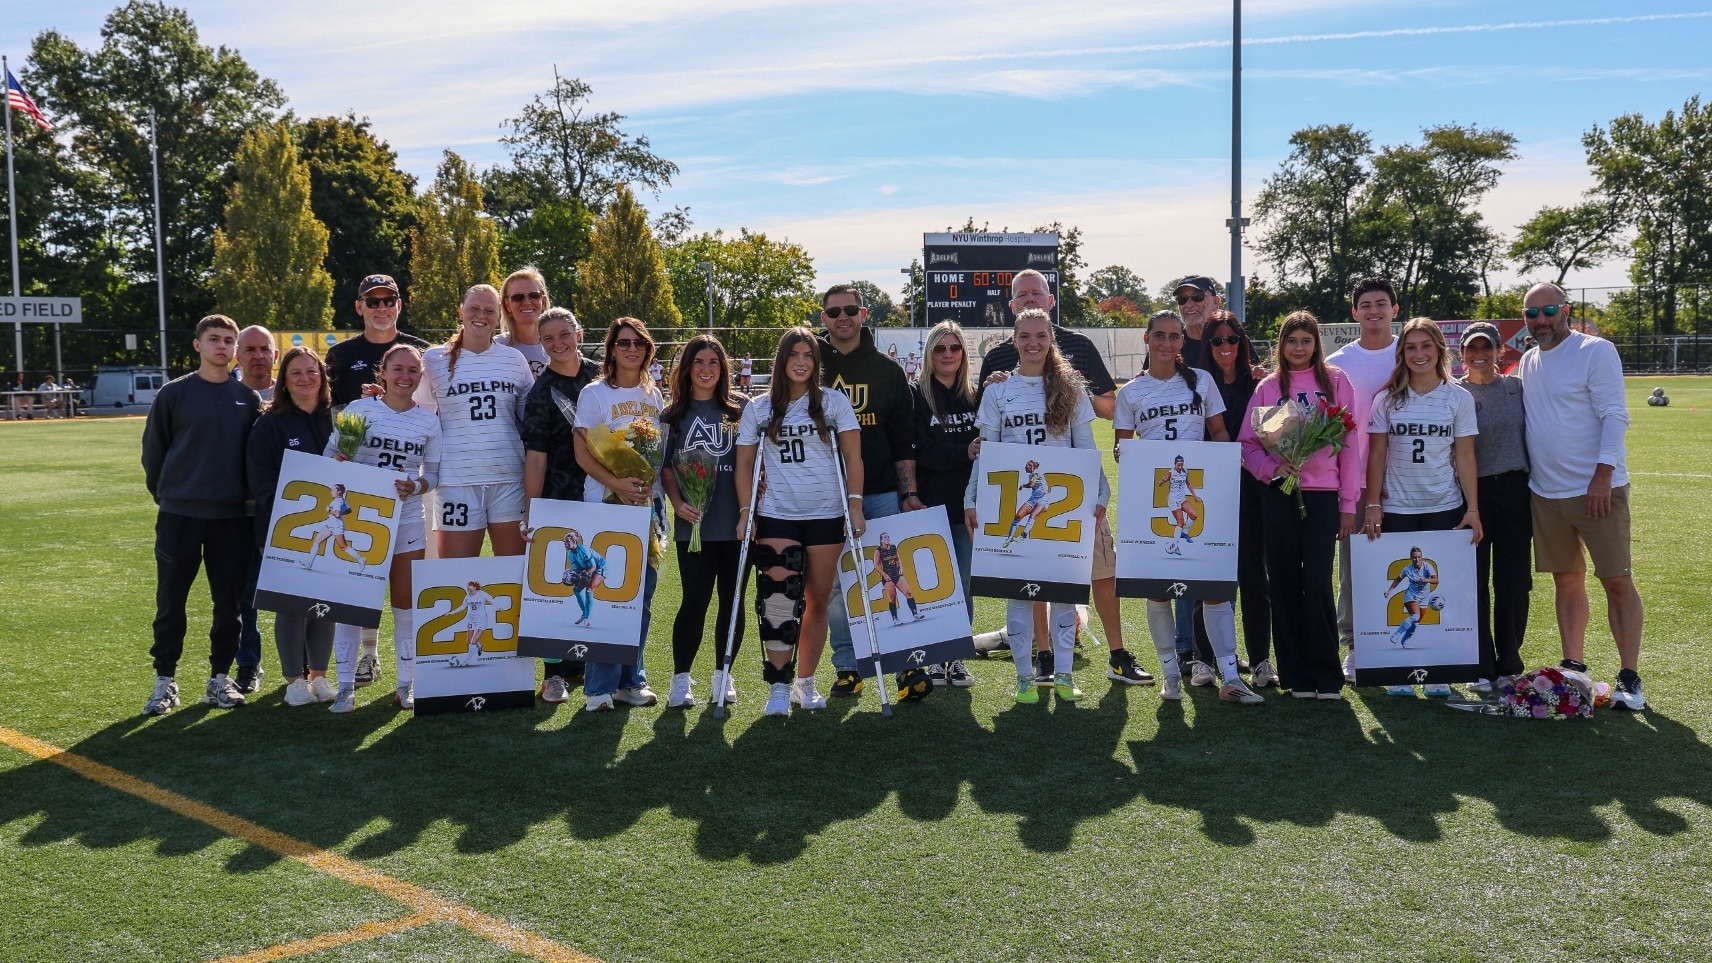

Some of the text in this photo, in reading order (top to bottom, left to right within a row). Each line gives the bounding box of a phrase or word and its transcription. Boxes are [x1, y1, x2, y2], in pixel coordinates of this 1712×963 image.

[952, 234, 1032, 244] NYU Winthrop Hospital
[934, 273, 965, 283] HOME
[973, 272, 1012, 286] 60:00
[950, 284, 958, 299] 0
[22, 302, 73, 317] FIELD
[1320, 327, 1360, 336] SEVENTH
[446, 380, 514, 397] ADELPHI
[468, 394, 497, 421] 23
[611, 400, 658, 421] ADELPH
[1139, 403, 1203, 423] ADELPHI
[1004, 412, 1047, 428] ADEL
[1164, 418, 1178, 440] 5
[289, 437, 300, 446] 25
[366, 436, 425, 457] DELPH
[684, 415, 733, 457] AU
[1025, 428, 1047, 446] 12
[779, 438, 806, 463] 20
[1412, 438, 1425, 464] 2
[377, 452, 407, 473] 25
[983, 470, 1085, 543] 12
[1150, 467, 1206, 539] 5
[270, 479, 397, 566] 25
[442, 501, 469, 527] 23
[527, 526, 644, 603] 00
[841, 533, 956, 618] 20
[1387, 557, 1441, 627] 2
[416, 582, 523, 657] 23
